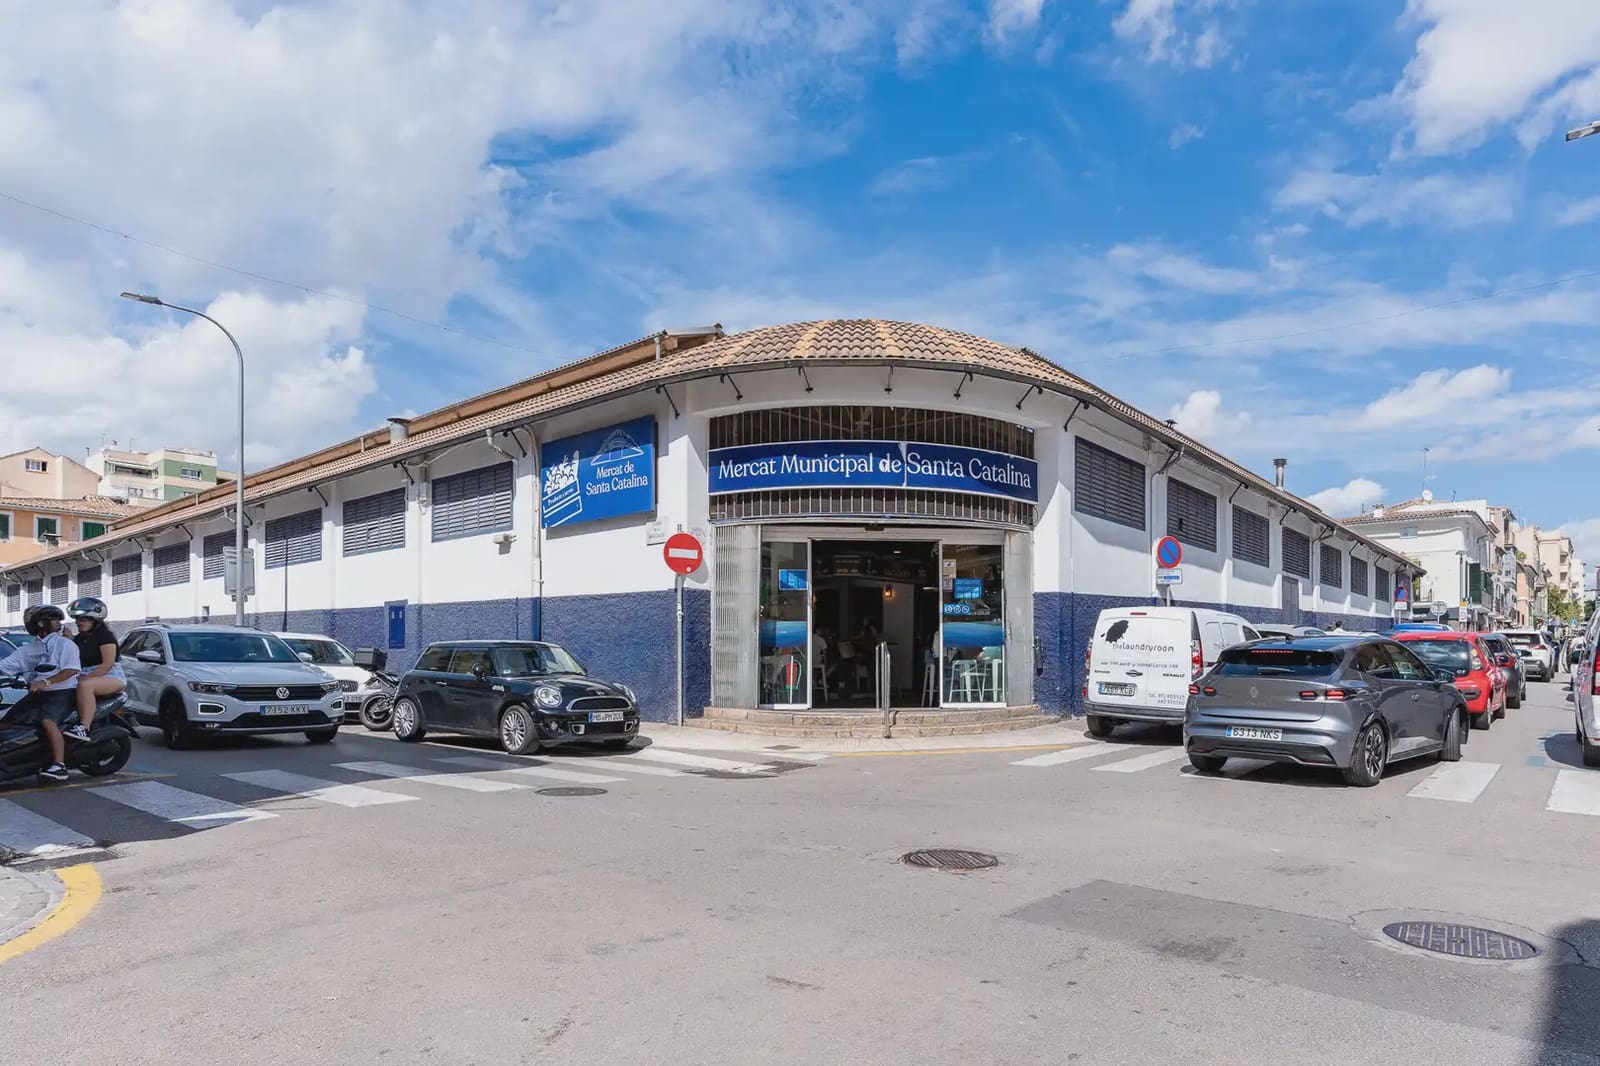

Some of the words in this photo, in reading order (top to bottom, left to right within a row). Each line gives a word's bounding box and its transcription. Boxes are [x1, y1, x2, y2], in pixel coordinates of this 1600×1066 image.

[596, 466, 623, 479] Mercat
[624, 462, 635, 473] de
[718, 460, 776, 481] Mercat
[780, 453, 873, 478] Municipal
[878, 455, 902, 473] de
[905, 452, 965, 477] Santa
[968, 458, 1032, 489] Catalina
[586, 482, 610, 496] Santa
[611, 474, 649, 492] Catalina
[1233, 727, 1258, 738] 6313
[1260, 729, 1280, 740] NKS
